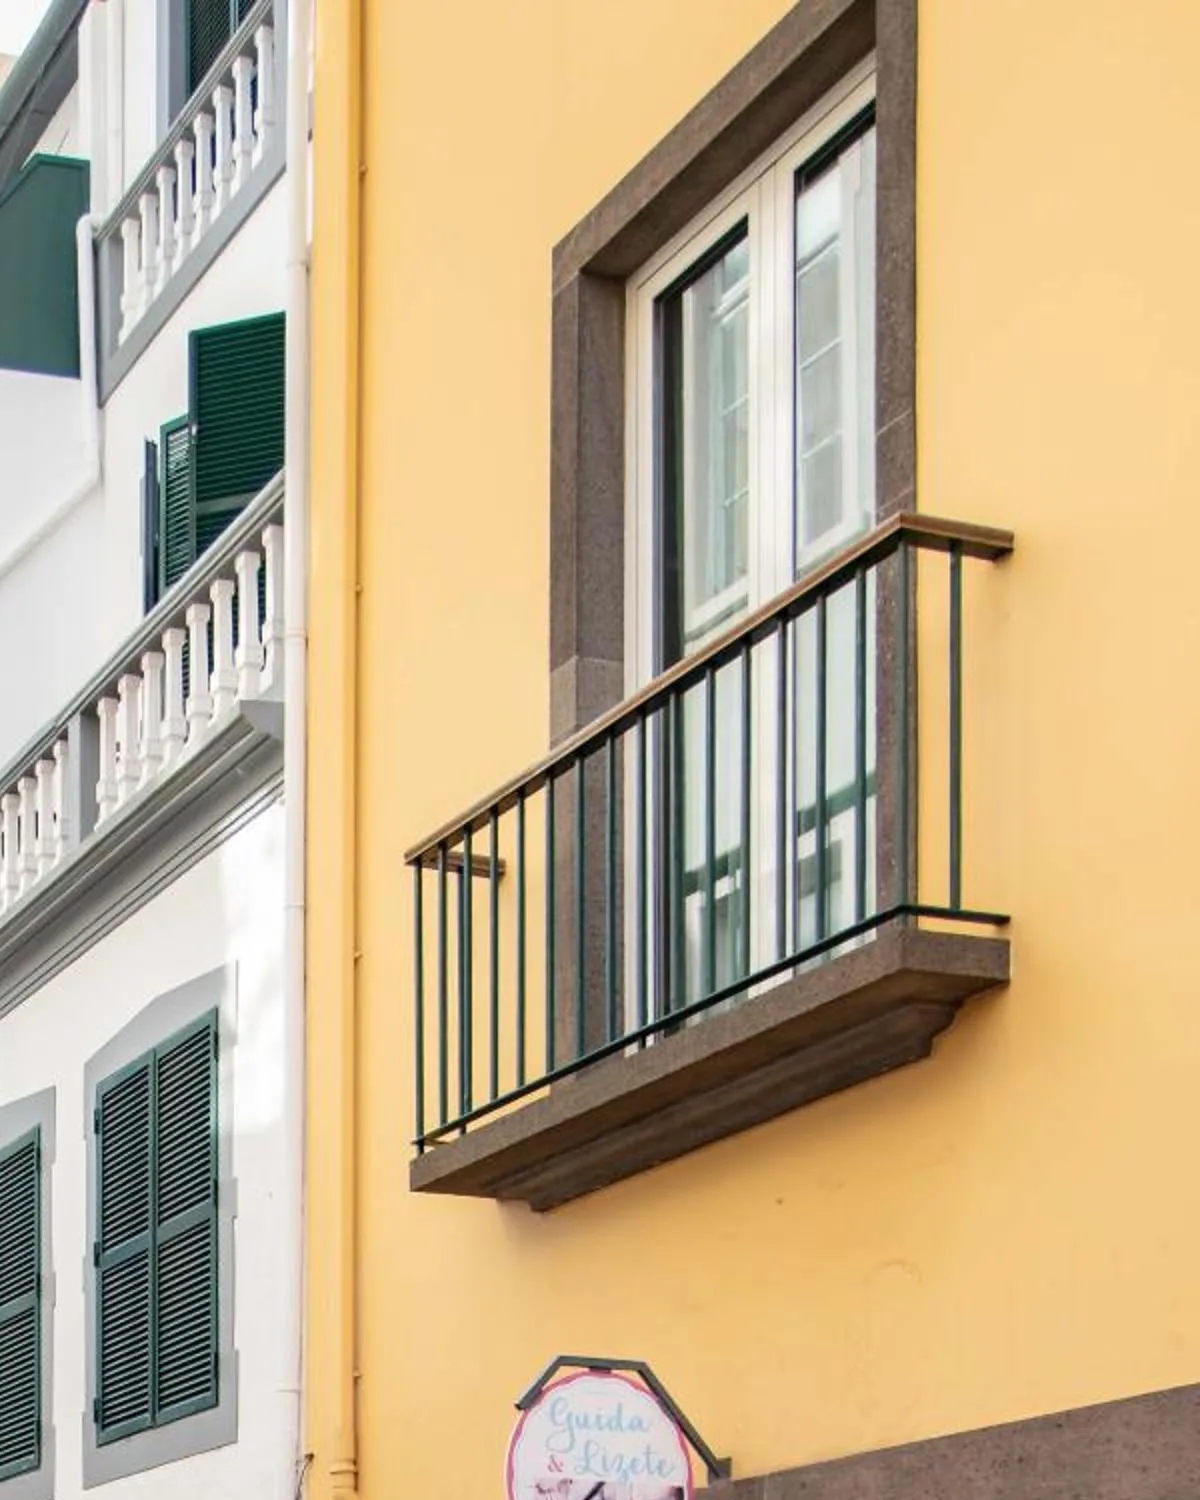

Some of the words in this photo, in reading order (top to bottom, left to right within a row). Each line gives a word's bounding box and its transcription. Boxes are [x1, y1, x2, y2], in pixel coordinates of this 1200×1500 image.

[546, 1396, 648, 1453] Guida
[547, 1454, 564, 1474] &
[573, 1440, 675, 1482] Lizete
